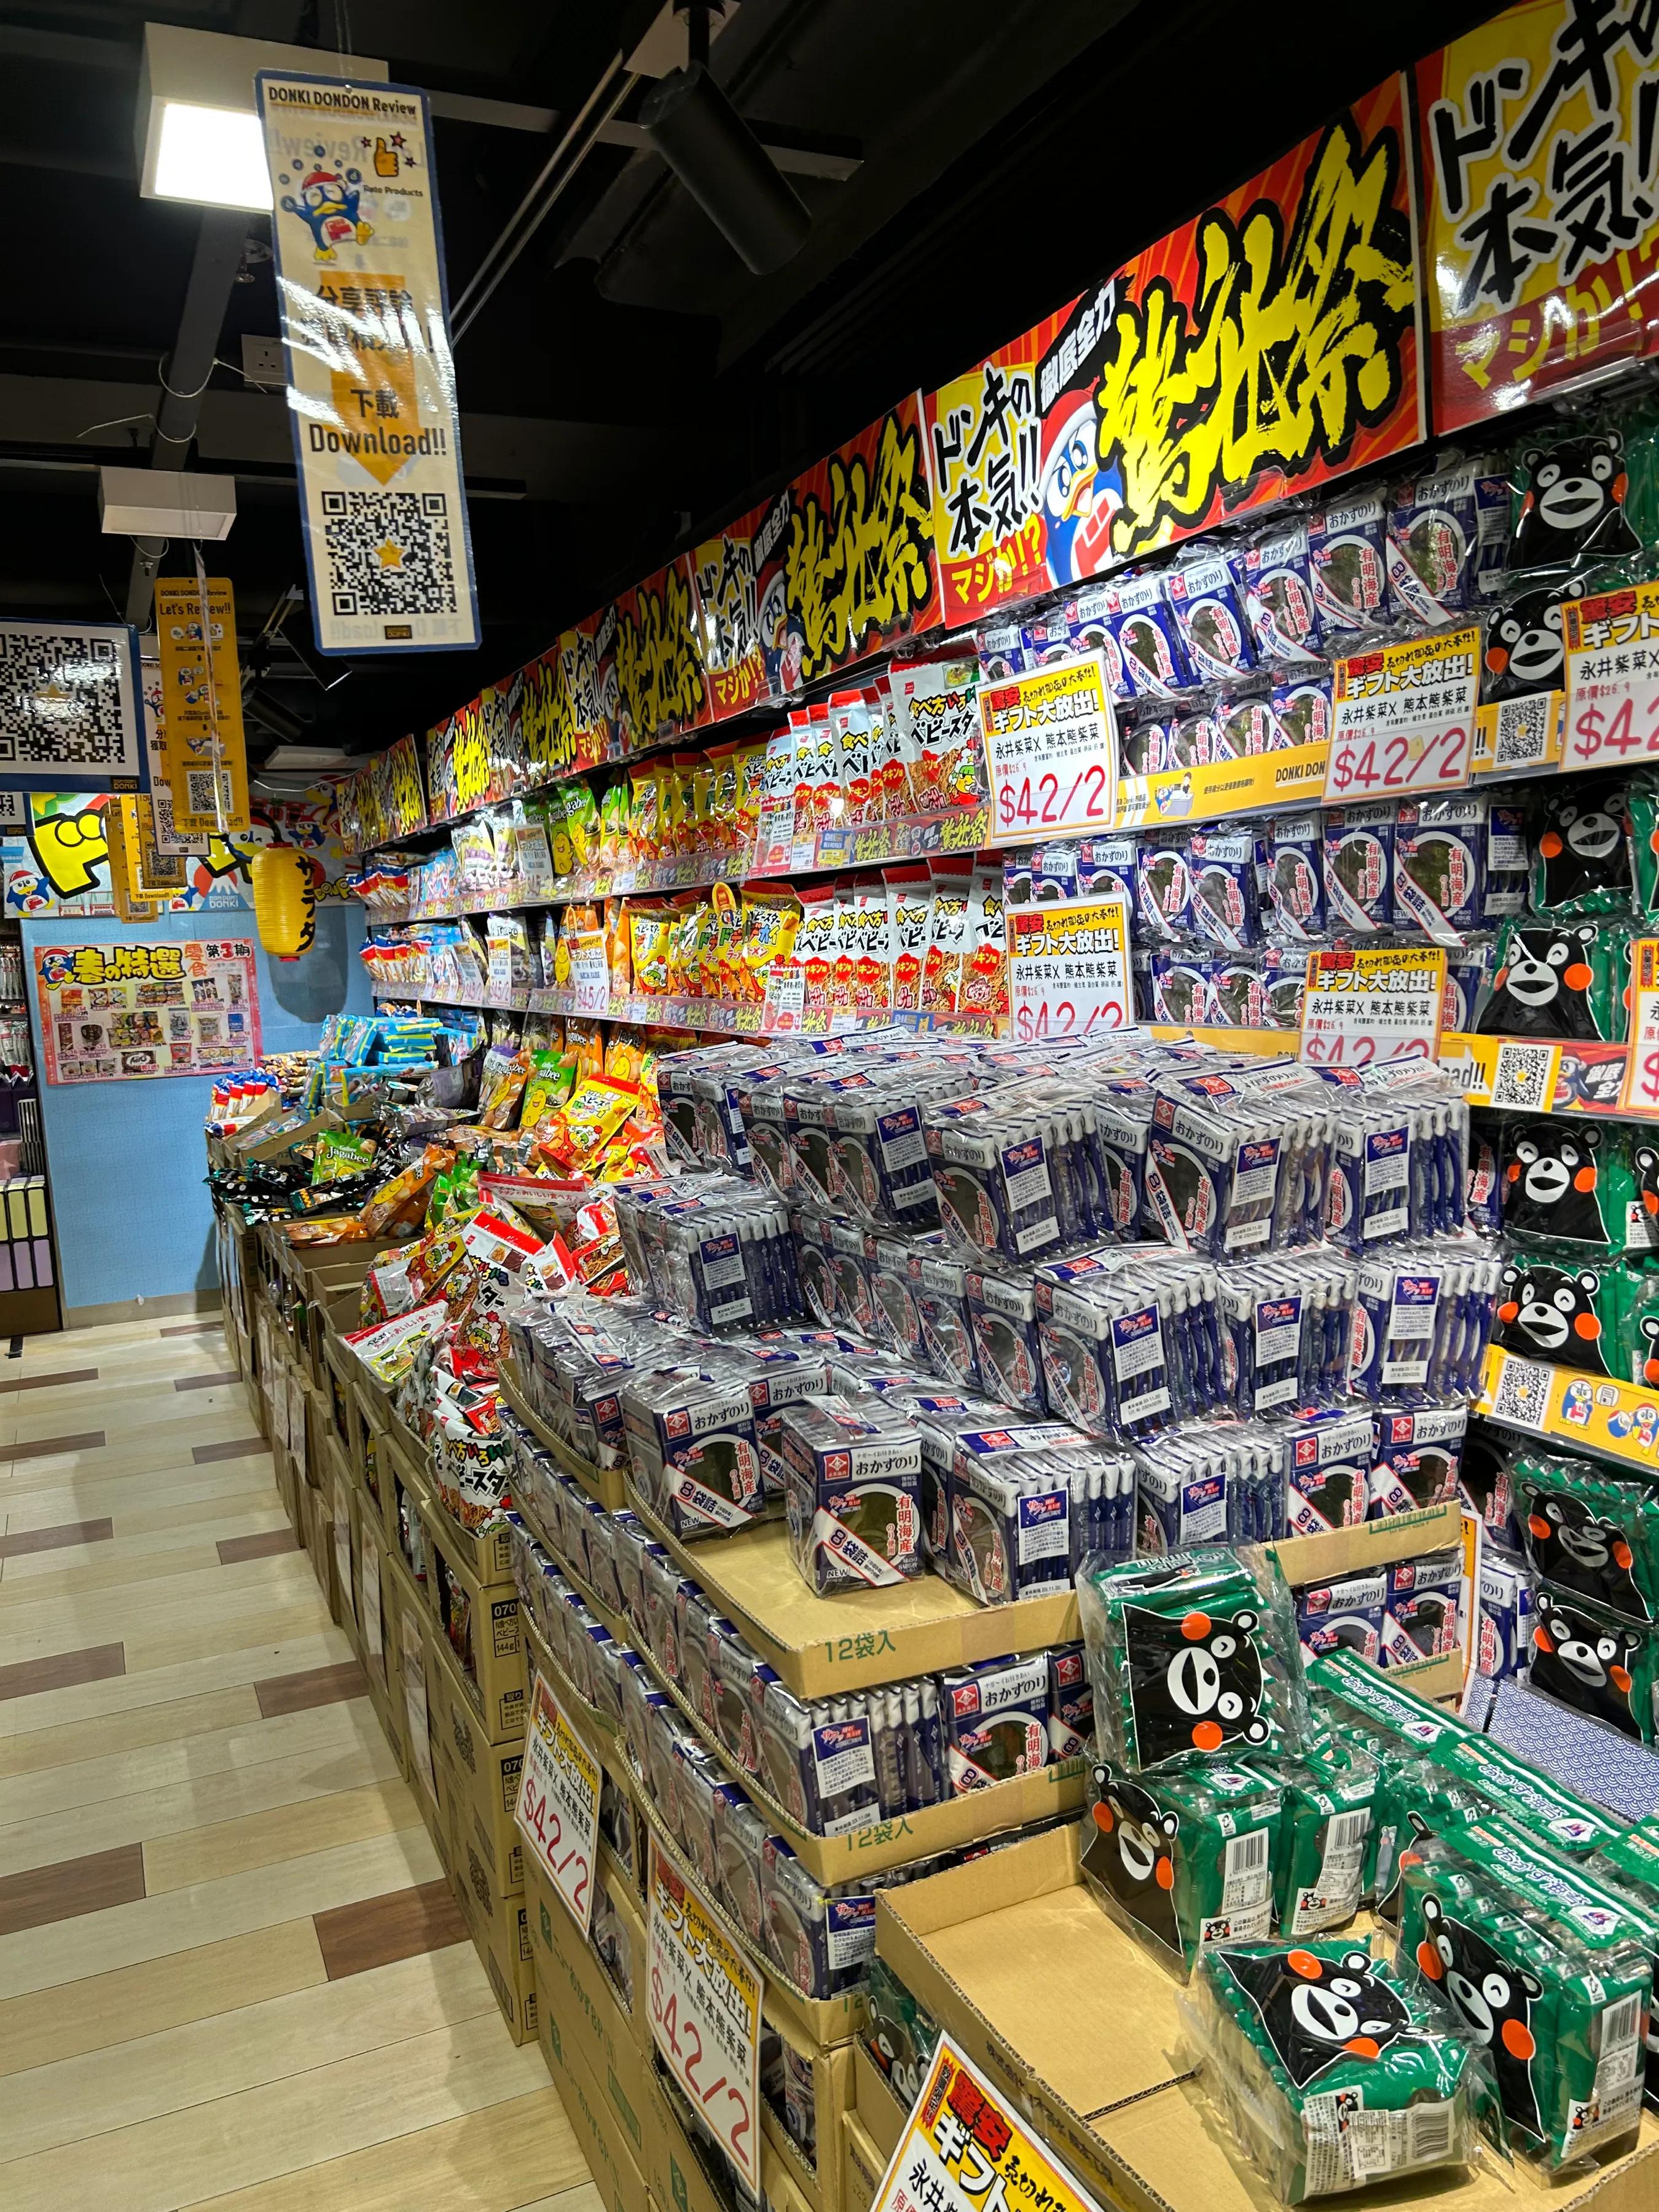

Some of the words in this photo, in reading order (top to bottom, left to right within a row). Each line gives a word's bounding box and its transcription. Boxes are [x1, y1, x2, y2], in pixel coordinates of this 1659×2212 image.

[269, 87, 310, 103] DONKI
[314, 91, 369, 110] DONDON
[372, 97, 416, 115] Review
[350, 389, 399, 419] 下載
[310, 424, 447, 455] Download!!
[936, 369, 1032, 482] ドンキの
[1418, 477, 1469, 503] おかずのり
[1329, 503, 1376, 529] おかずのり
[1437, 530, 1457, 591] 有明海産
[1187, 570, 1223, 594] おかずのり
[1359, 547, 1380, 609] 有明海産
[160, 603, 184, 615] Let's
[187, 603, 230, 614] Reew!!
[1121, 587, 1153, 608] おかずのり
[1285, 577, 1310, 633] 有明海産
[1212, 606, 1239, 657] 有明海産
[1153, 629, 1172, 677] 有明海産
[1347, 653, 1473, 699] ギフト大放出!
[995, 689, 1099, 734] ギフト大放出!
[1403, 686, 1468, 715] 熊本熊紫菜
[1046, 723, 1100, 750] 熊本熊紫菜
[1275, 763, 1304, 783] DONKI
[1333, 727, 1466, 791] $42/2
[1000, 765, 1105, 827] $42/2
[1276, 824, 1311, 837] おかずのり
[1346, 806, 1391, 823] おかずのり
[1043, 859, 1069, 873] おかずのり
[1095, 847, 1129, 863] おかずのり
[1366, 842, 1379, 900] 有明海産
[1172, 863, 1182, 912] 有明海産
[1295, 863, 1312, 916] 有明海産
[1449, 848, 1465, 907] 有明海産
[1226, 877, 1244, 927] 有明海産
[207, 942, 250, 959] 第3期
[1016, 928, 1120, 957] ギフト大放出!
[73, 946, 186, 985] 春の特選
[184, 944, 208, 977] 零食
[1065, 960, 1118, 978] 熊本熊紫菜
[1317, 970, 1437, 993] ギフト大放出!
[578, 986, 605, 1013] $45/2
[1370, 998, 1431, 1017] 熊本熊紫菜
[1174, 1120, 1225, 1156] おかずのり
[326, 1147, 369, 1164] Jagabee
[977, 1190, 997, 1249] 有明海産
[1193, 1175, 1210, 1237] 有明海産
[1055, 1302, 1097, 1333] おかずのり
[1014, 1338, 1033, 1395] 有明海産
[773, 1379, 824, 1402] おかずのり
[1083, 1354, 1099, 1414] 有明海産
[695, 1402, 750, 1430] おかずのり
[1417, 1418, 1466, 1440] おかずのり
[1322, 1433, 1371, 1459] おかずのり
[737, 1440, 757, 1497] 有明海産
[856, 1454, 919, 1476] おかずのり
[679, 1480, 718, 1514] 8袋詰
[1494, 1473, 1507, 1528] 有明海産
[896, 1494, 915, 1555] 有明海産
[830, 1527, 869, 1568] 8袋詰
[1418, 1564, 1462, 1585] おかずのり
[1332, 1588, 1385, 1608] おかずのり
[1442, 1600, 1456, 1653] 有明海産
[496, 1642, 514, 1652] 144g
[826, 1630, 896, 1664] 12袋入
[1481, 1617, 1495, 1674] 有明海産
[985, 1675, 1046, 1707] おかずのり
[1478, 1762, 1571, 1820] おかず海苔
[524, 1775, 589, 1913] $42/2
[1492, 1847, 1593, 1905] おかず海苔
[651, 1966, 750, 2167] $42/2
